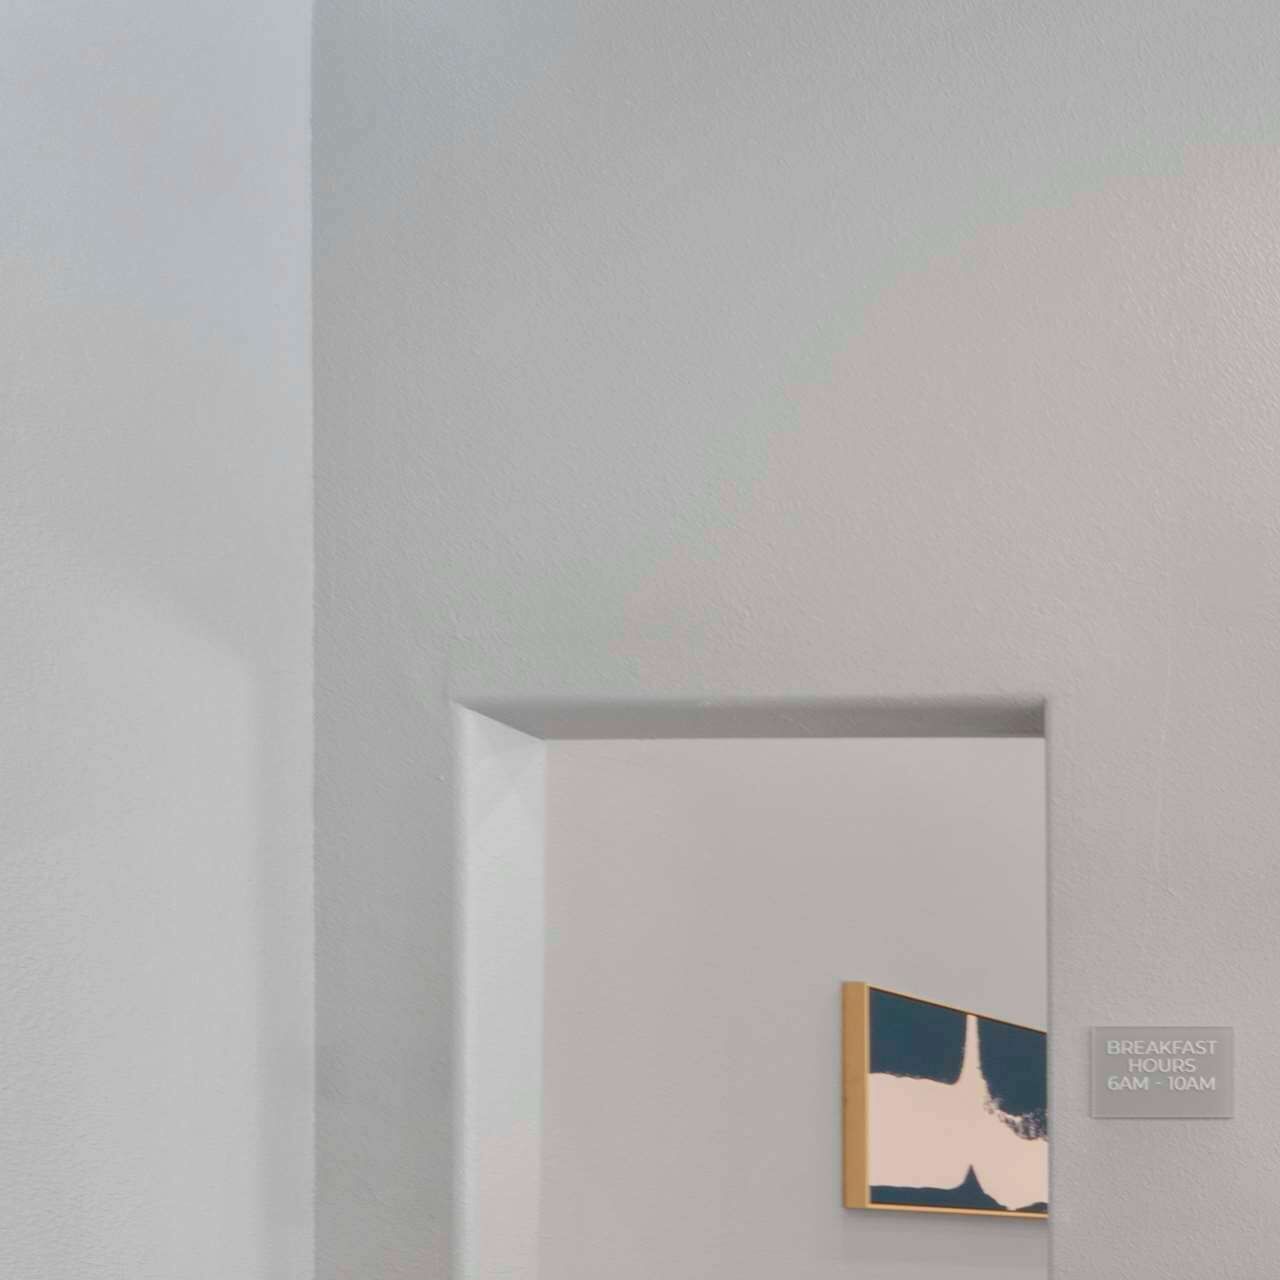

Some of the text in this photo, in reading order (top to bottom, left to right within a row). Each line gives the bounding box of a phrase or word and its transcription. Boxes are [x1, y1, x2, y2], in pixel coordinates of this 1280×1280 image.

[1106, 1040, 1218, 1055] BREAKFAST
[1128, 1058, 1197, 1072] HOURS
[1107, 1076, 1149, 1090] 6AM
[1168, 1076, 1216, 1090] 10AM
